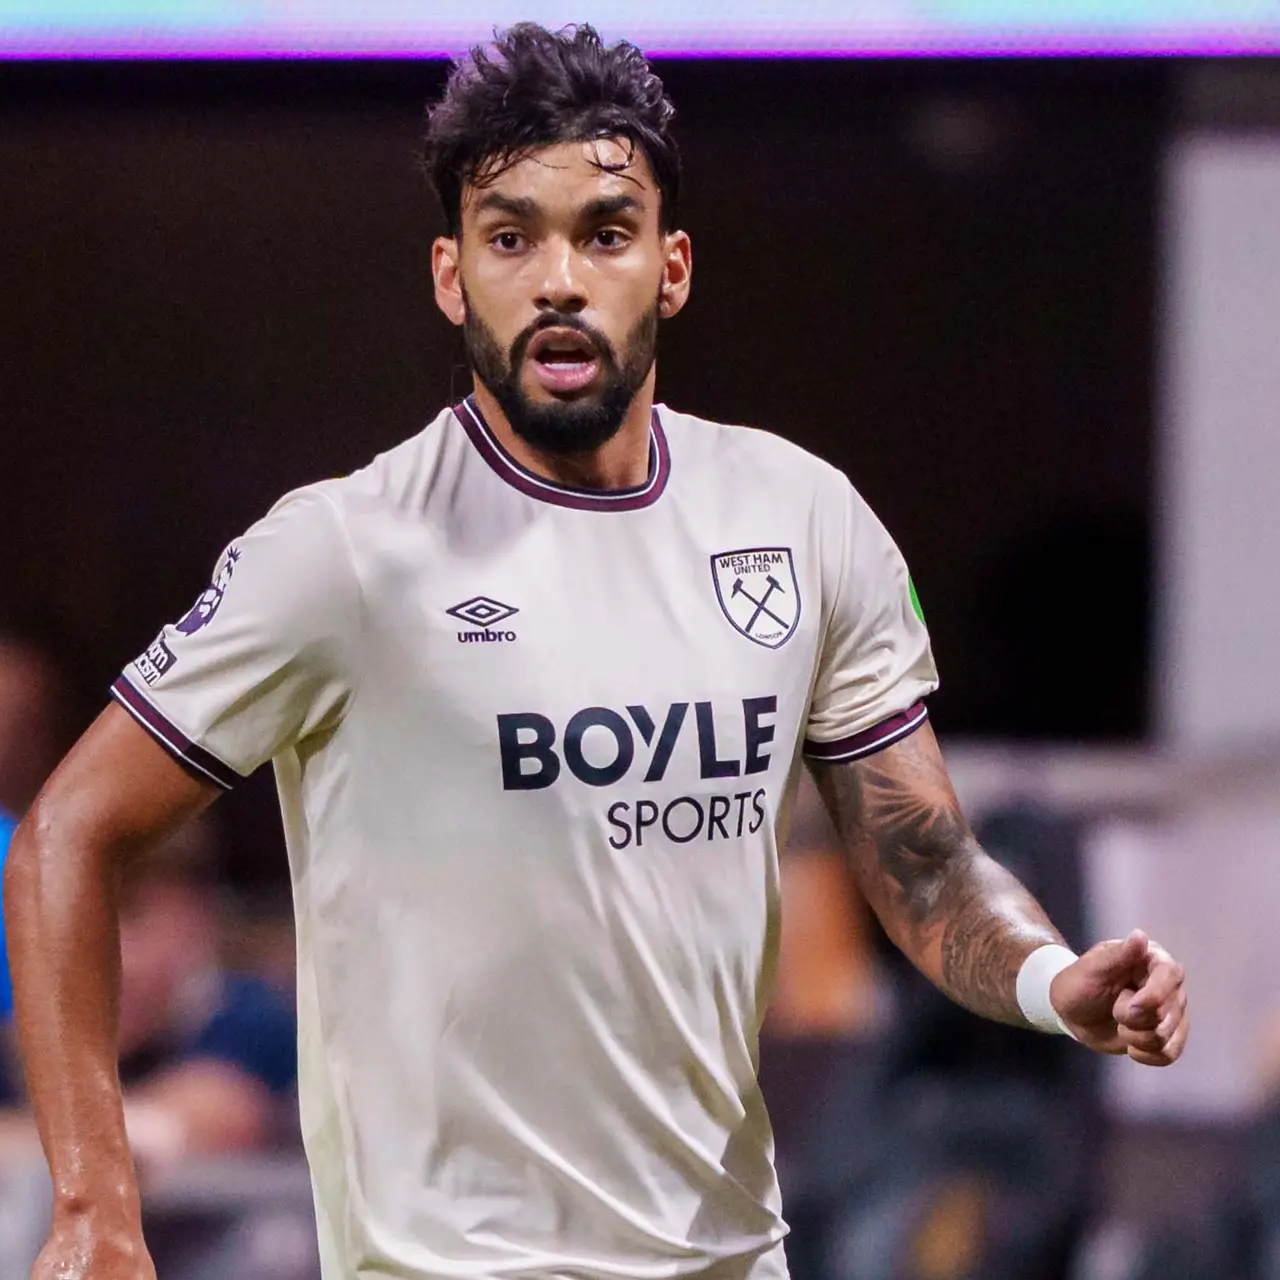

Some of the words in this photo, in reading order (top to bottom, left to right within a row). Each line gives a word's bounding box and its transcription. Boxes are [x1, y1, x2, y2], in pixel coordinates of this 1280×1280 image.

[720, 555, 751, 569] WEST
[753, 553, 783, 565] HAM
[733, 564, 771, 575] UNITED
[457, 628, 517, 643] umbro
[497, 695, 777, 790] BOYLE
[607, 788, 766, 850] SPORTS
